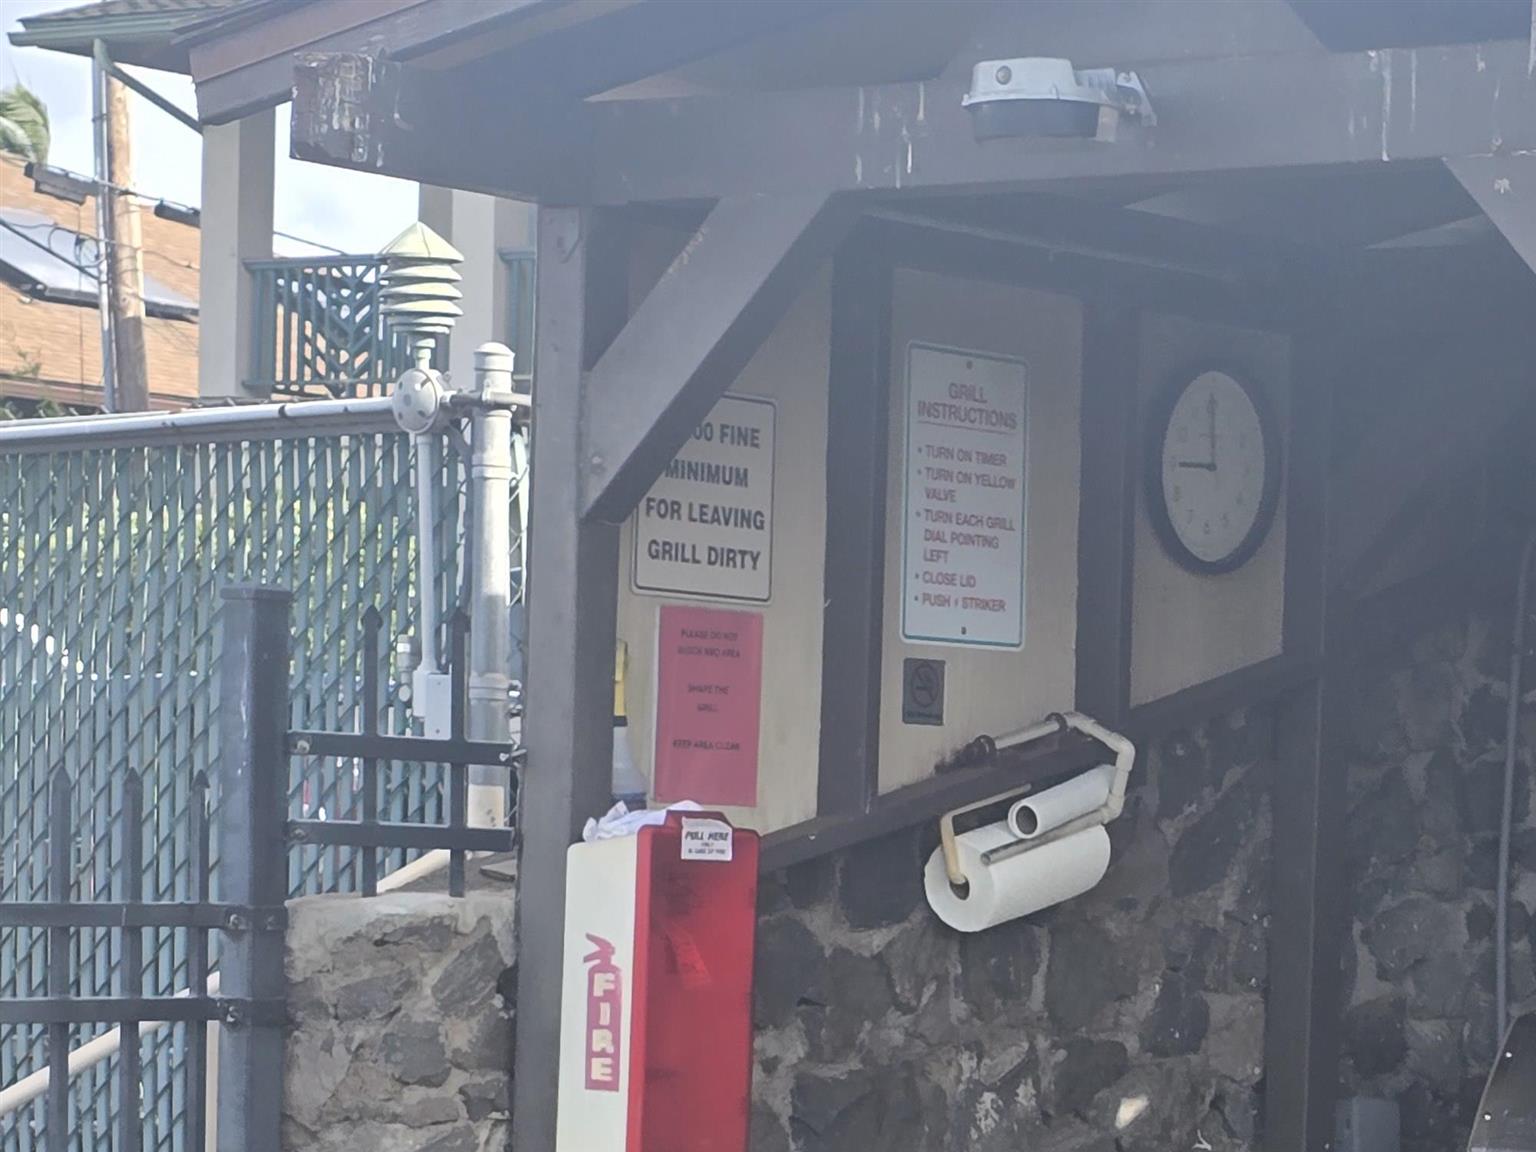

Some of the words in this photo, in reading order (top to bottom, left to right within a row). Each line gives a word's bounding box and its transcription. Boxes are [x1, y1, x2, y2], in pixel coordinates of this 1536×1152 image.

[948, 382, 987, 403] GRILL
[918, 400, 1017, 429] INSTRUCTIONS
[719, 423, 760, 449] FINE
[925, 444, 954, 460] TURN
[957, 448, 973, 462] ON
[975, 451, 1007, 465] TIMER
[664, 459, 748, 487] MINIMUM
[925, 467, 953, 481] TURN
[956, 471, 972, 484] ON
[975, 474, 1016, 489] YELLOW
[925, 488, 956, 502] VALVE
[645, 497, 682, 520] FOR
[688, 502, 765, 530] LEAVING
[924, 508, 953, 524] TURN
[956, 512, 984, 526] EACH
[986, 516, 1015, 531] GRILL
[924, 529, 947, 543] DIAL
[950, 532, 999, 549] POINTING
[648, 539, 701, 564] GRILL
[707, 546, 760, 570] DIRTY
[923, 548, 949, 563] LEFT
[922, 571, 958, 586] CLOSE
[960, 575, 976, 587] LID
[922, 593, 950, 606] PUSH
[961, 596, 1006, 611] STRIKER
[591, 972, 616, 1081] FIRE
